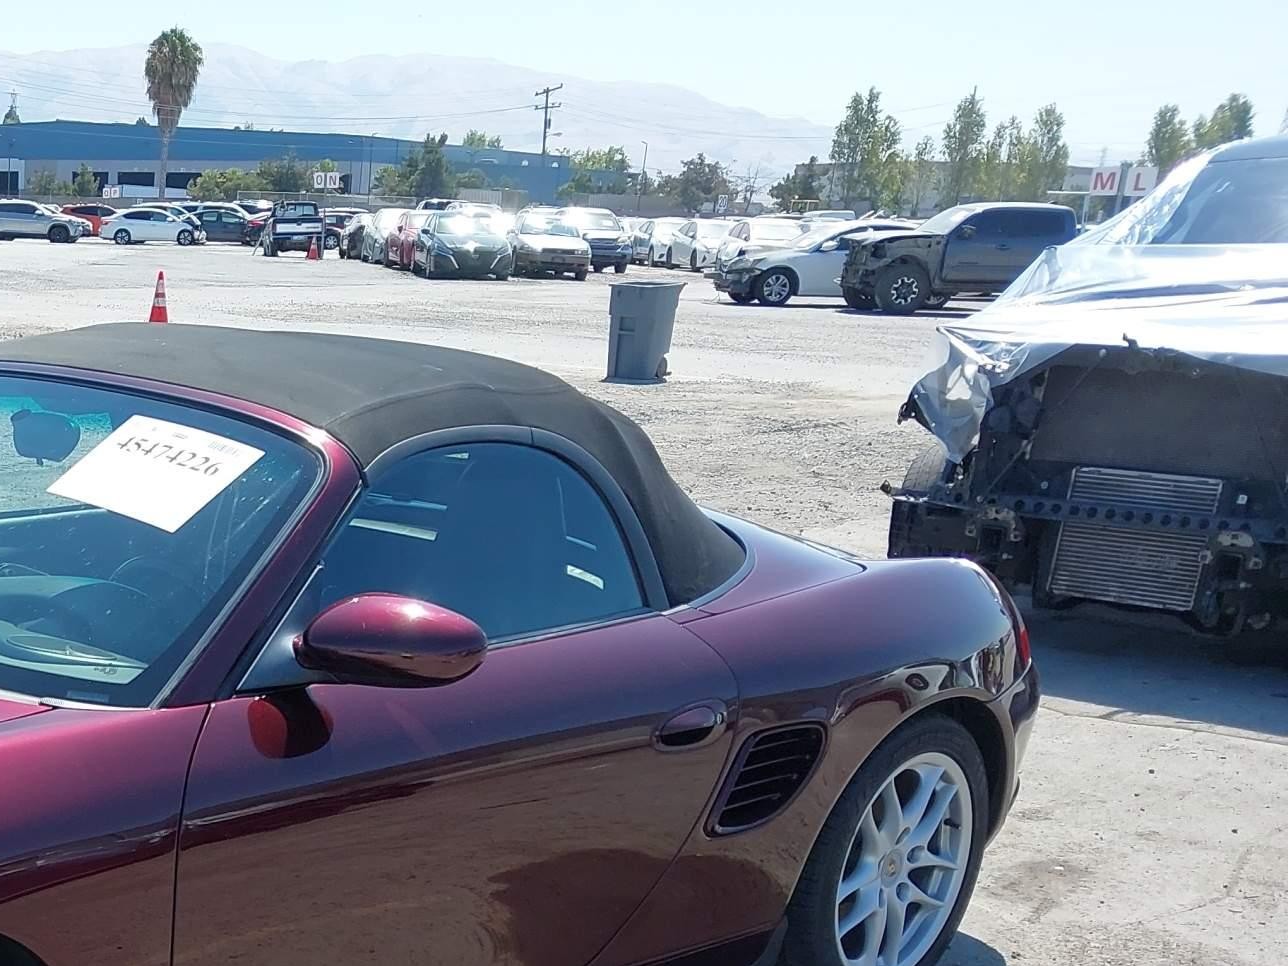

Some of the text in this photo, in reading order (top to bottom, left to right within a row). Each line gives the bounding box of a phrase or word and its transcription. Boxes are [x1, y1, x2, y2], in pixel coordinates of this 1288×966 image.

[1093, 172, 1146, 191] M L
[116, 436, 223, 477] 45474226
